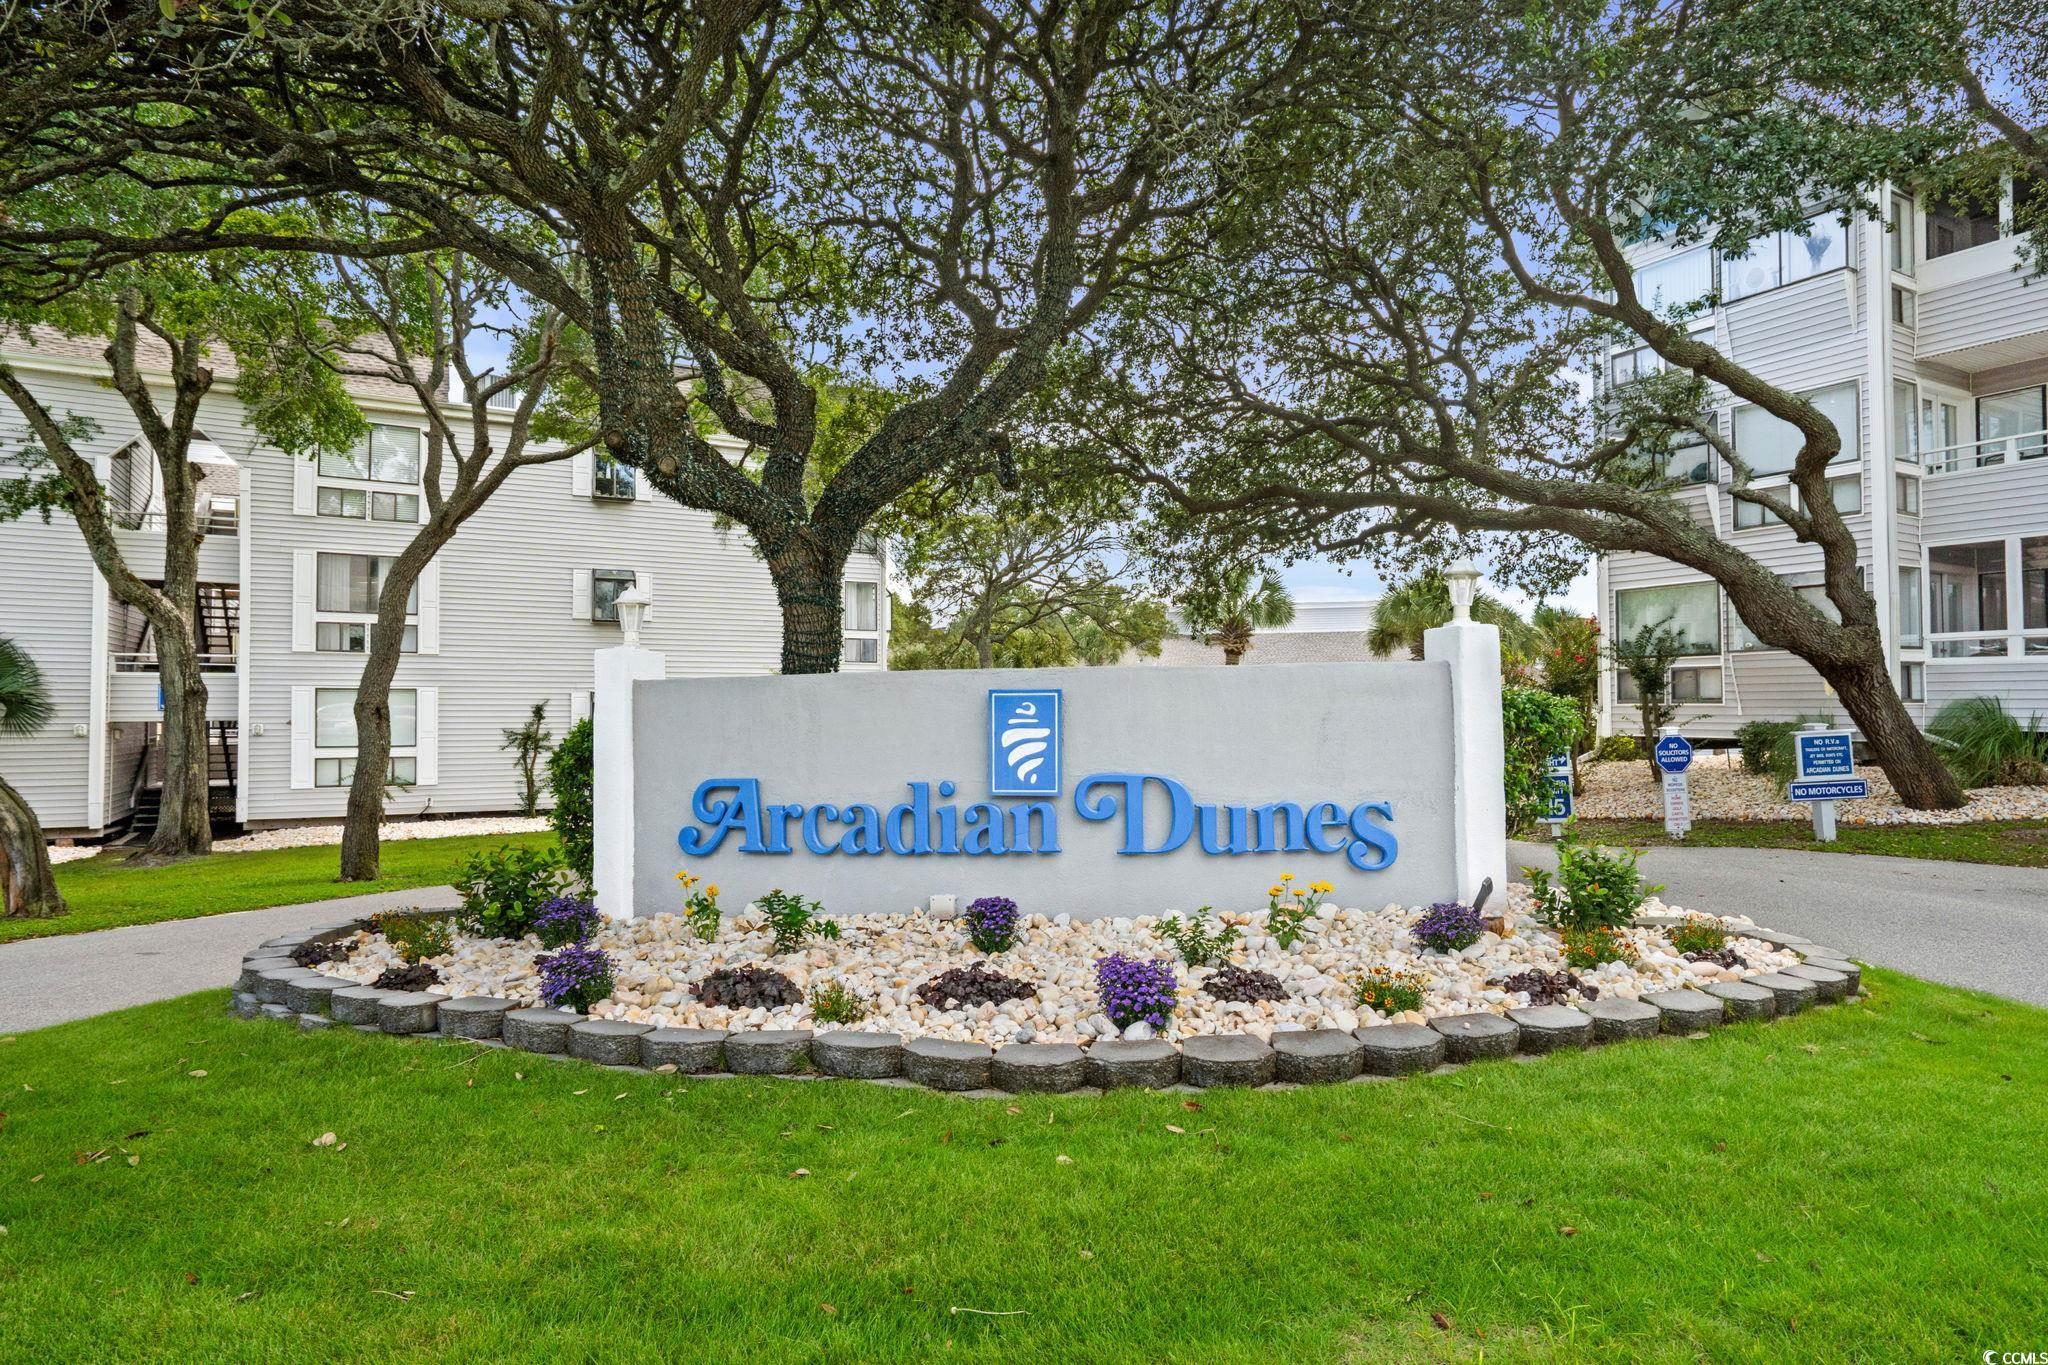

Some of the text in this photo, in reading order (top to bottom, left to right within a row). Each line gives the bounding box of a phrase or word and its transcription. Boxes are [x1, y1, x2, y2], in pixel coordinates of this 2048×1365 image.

[1795, 786, 1863, 796] NO MOTORCYCLES
[678, 772, 1399, 870] Arcadian Dunes
